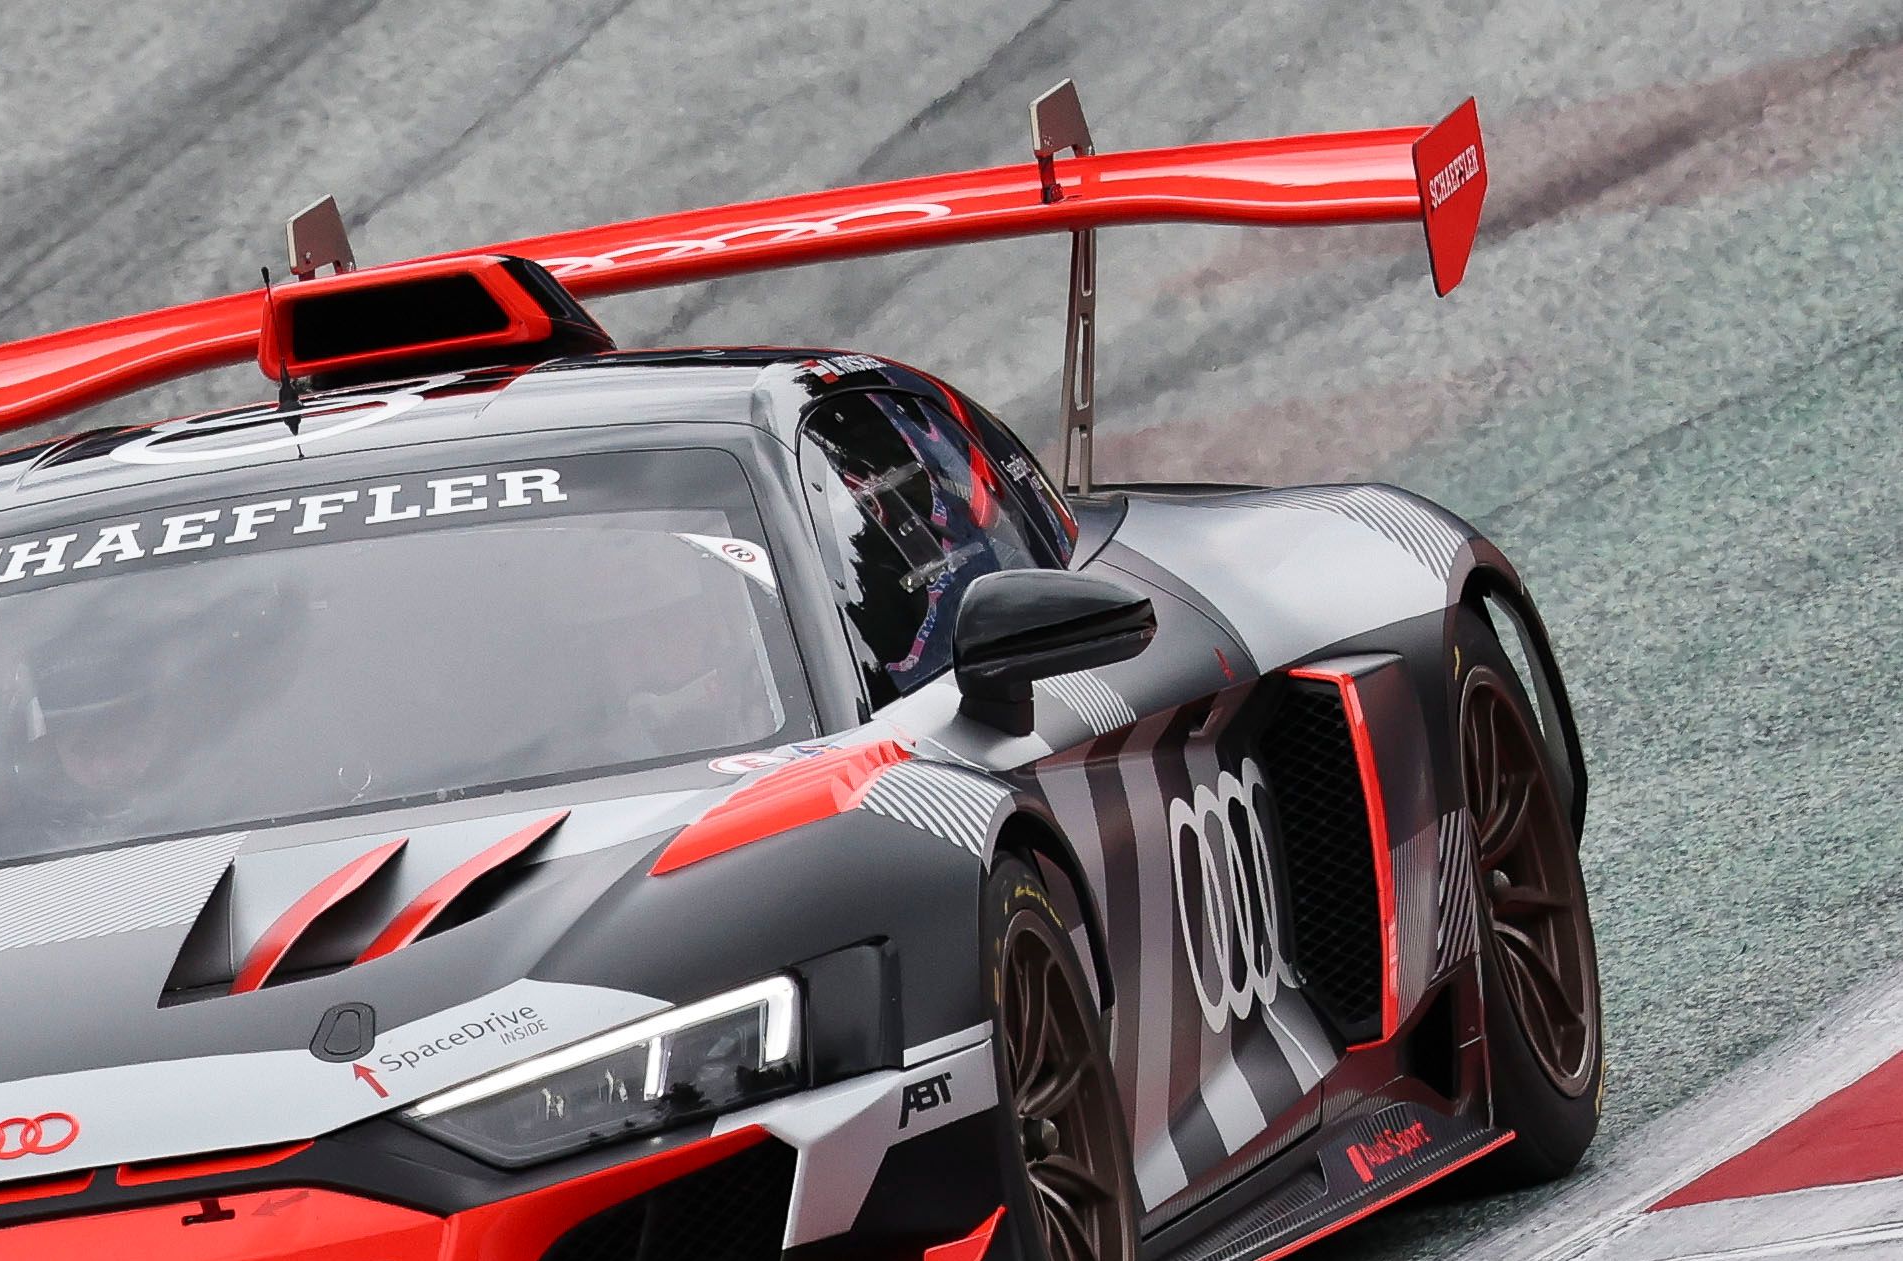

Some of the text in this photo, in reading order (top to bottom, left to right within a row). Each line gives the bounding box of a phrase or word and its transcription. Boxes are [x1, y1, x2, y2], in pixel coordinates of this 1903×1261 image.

[1429, 144, 1480, 209] SCHAEFFLER
[379, 1006, 538, 1072] SpaceDrive
[500, 1019, 549, 1046] INSIDE
[898, 1071, 953, 1131] ABT
